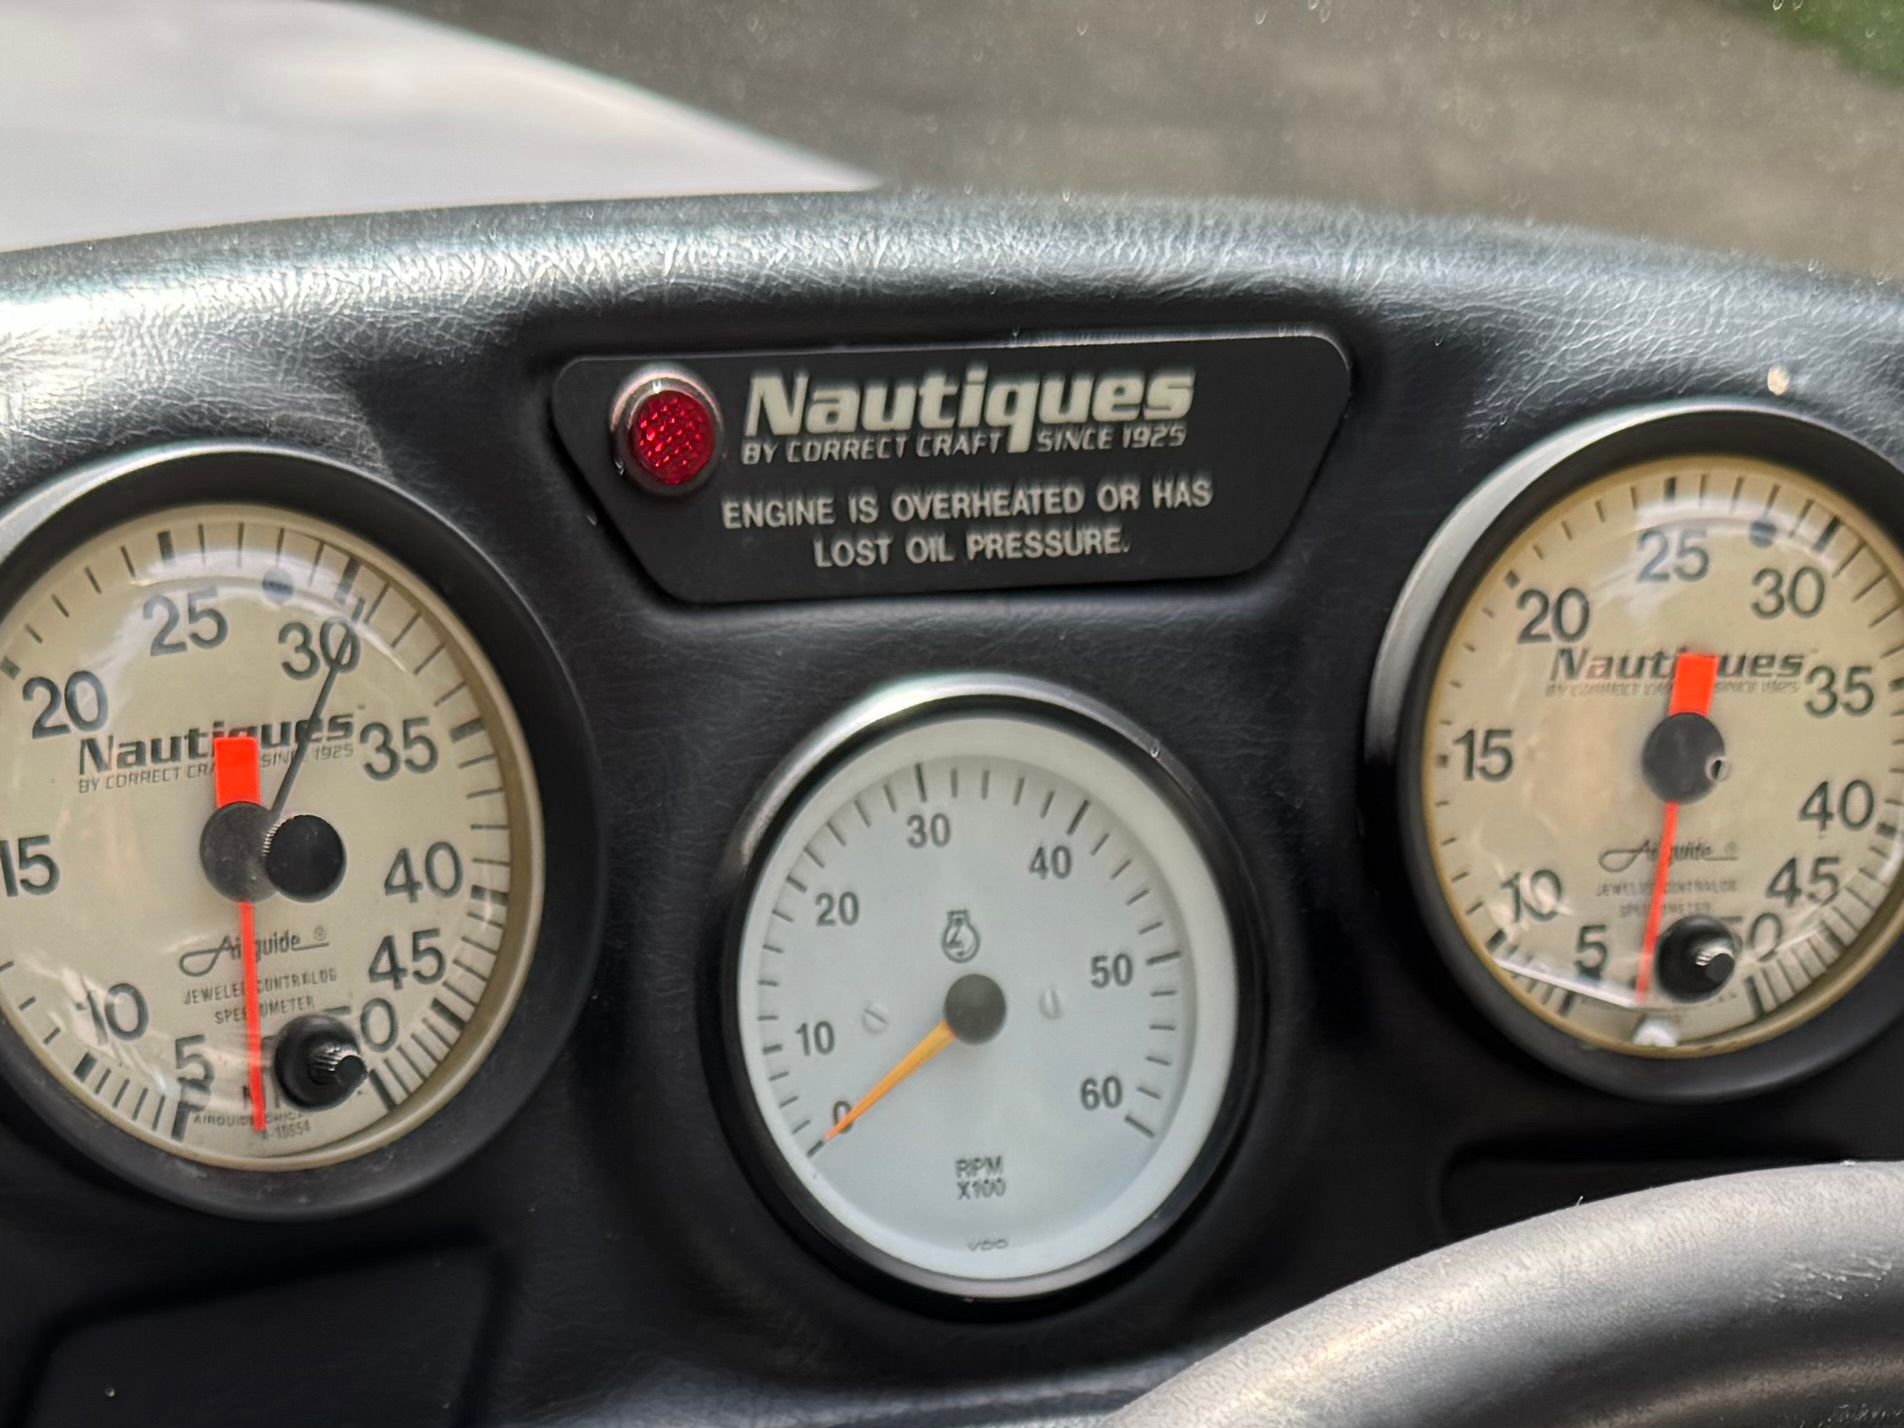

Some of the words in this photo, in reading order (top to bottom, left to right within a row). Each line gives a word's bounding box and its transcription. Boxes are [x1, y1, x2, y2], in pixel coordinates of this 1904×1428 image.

[744, 365, 1196, 453] Nautiques
[741, 439, 779, 465] BY
[786, 434, 905, 463] CORRECT
[916, 431, 1002, 459] CRAFT
[1036, 427, 1113, 453] SINCE
[1120, 423, 1187, 449] 1925
[722, 497, 835, 530] ENGINE
[848, 493, 879, 525] IS
[892, 484, 1085, 525] OVERHEATED
[1097, 481, 1140, 513] OR
[1152, 477, 1213, 510] HAS
[814, 538, 890, 569] LOST
[906, 534, 955, 564] OIL
[966, 526, 1132, 561] PRESSURE.
[1636, 530, 1709, 582] 25
[1516, 588, 1590, 643] 20
[1751, 566, 1826, 619] 30
[142, 588, 229, 657] 25
[278, 618, 362, 680] 30
[23, 670, 109, 739] 20
[1804, 666, 1875, 719] 35
[359, 716, 439, 781] 35
[1453, 728, 1515, 783] 15
[906, 814, 951, 847] 30
[1799, 780, 1875, 831] 40
[384, 841, 464, 903] 40
[1029, 846, 1072, 880] 40
[1765, 857, 1842, 907] 45
[815, 892, 860, 926] 20
[368, 928, 447, 990] 45
[1090, 955, 1134, 987] 50
[796, 1022, 836, 1055] 10
[1080, 1077, 1123, 1110] 60
[955, 1157, 1004, 1177] RPM
[957, 1177, 1006, 1200] X100
